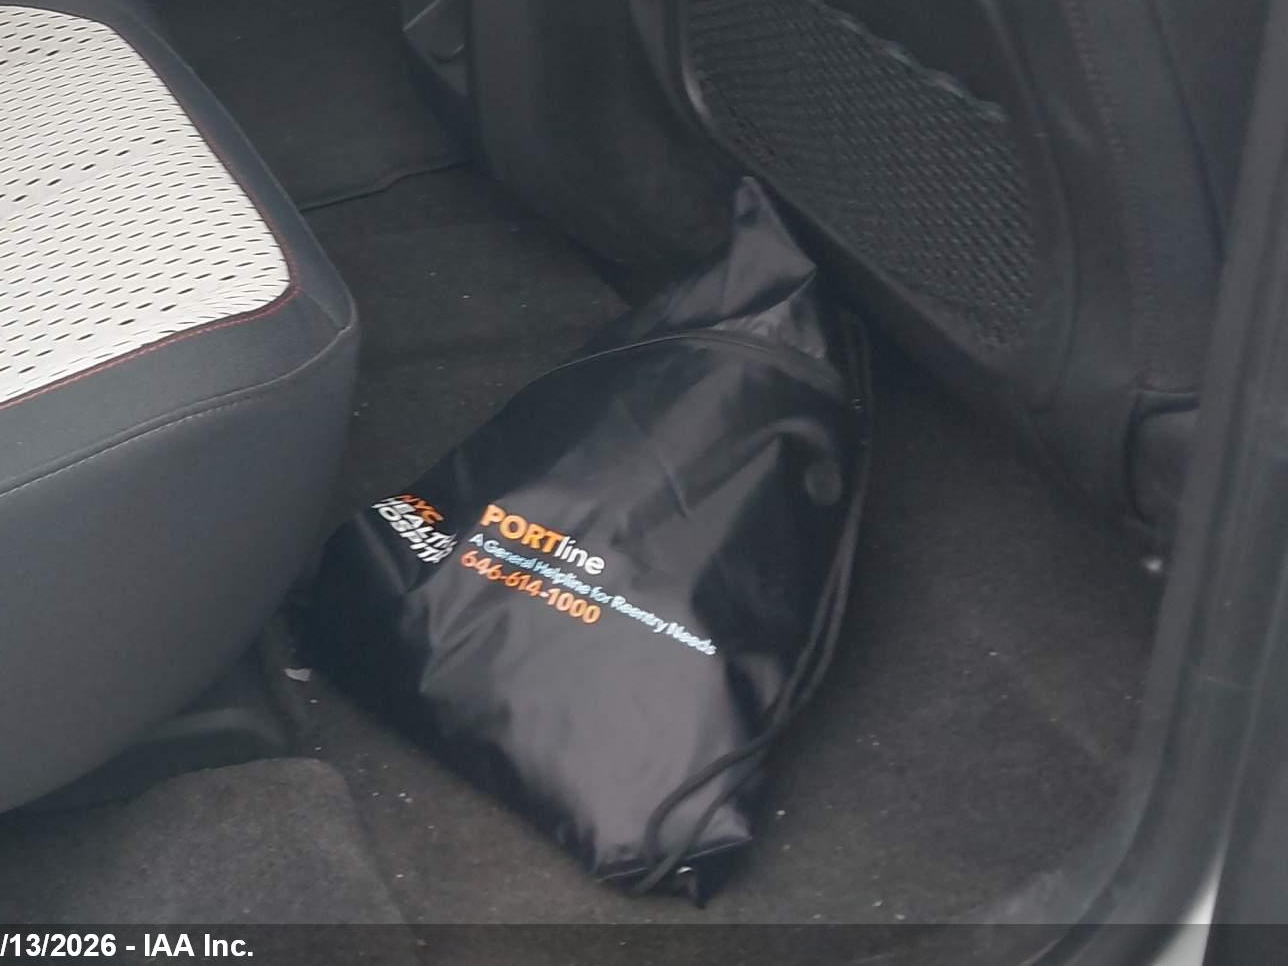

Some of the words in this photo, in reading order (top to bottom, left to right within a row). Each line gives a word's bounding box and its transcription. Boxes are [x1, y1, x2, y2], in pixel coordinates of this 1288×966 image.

[481, 504, 605, 575] PORTline
[460, 549, 602, 624] 646-614-1000
[469, 533, 484, 547] A
[484, 540, 536, 570] General
[535, 559, 592, 596] Helpline
[591, 585, 612, 605] for
[610, 594, 669, 634] Reentry
[665, 622, 717, 656] Needs
